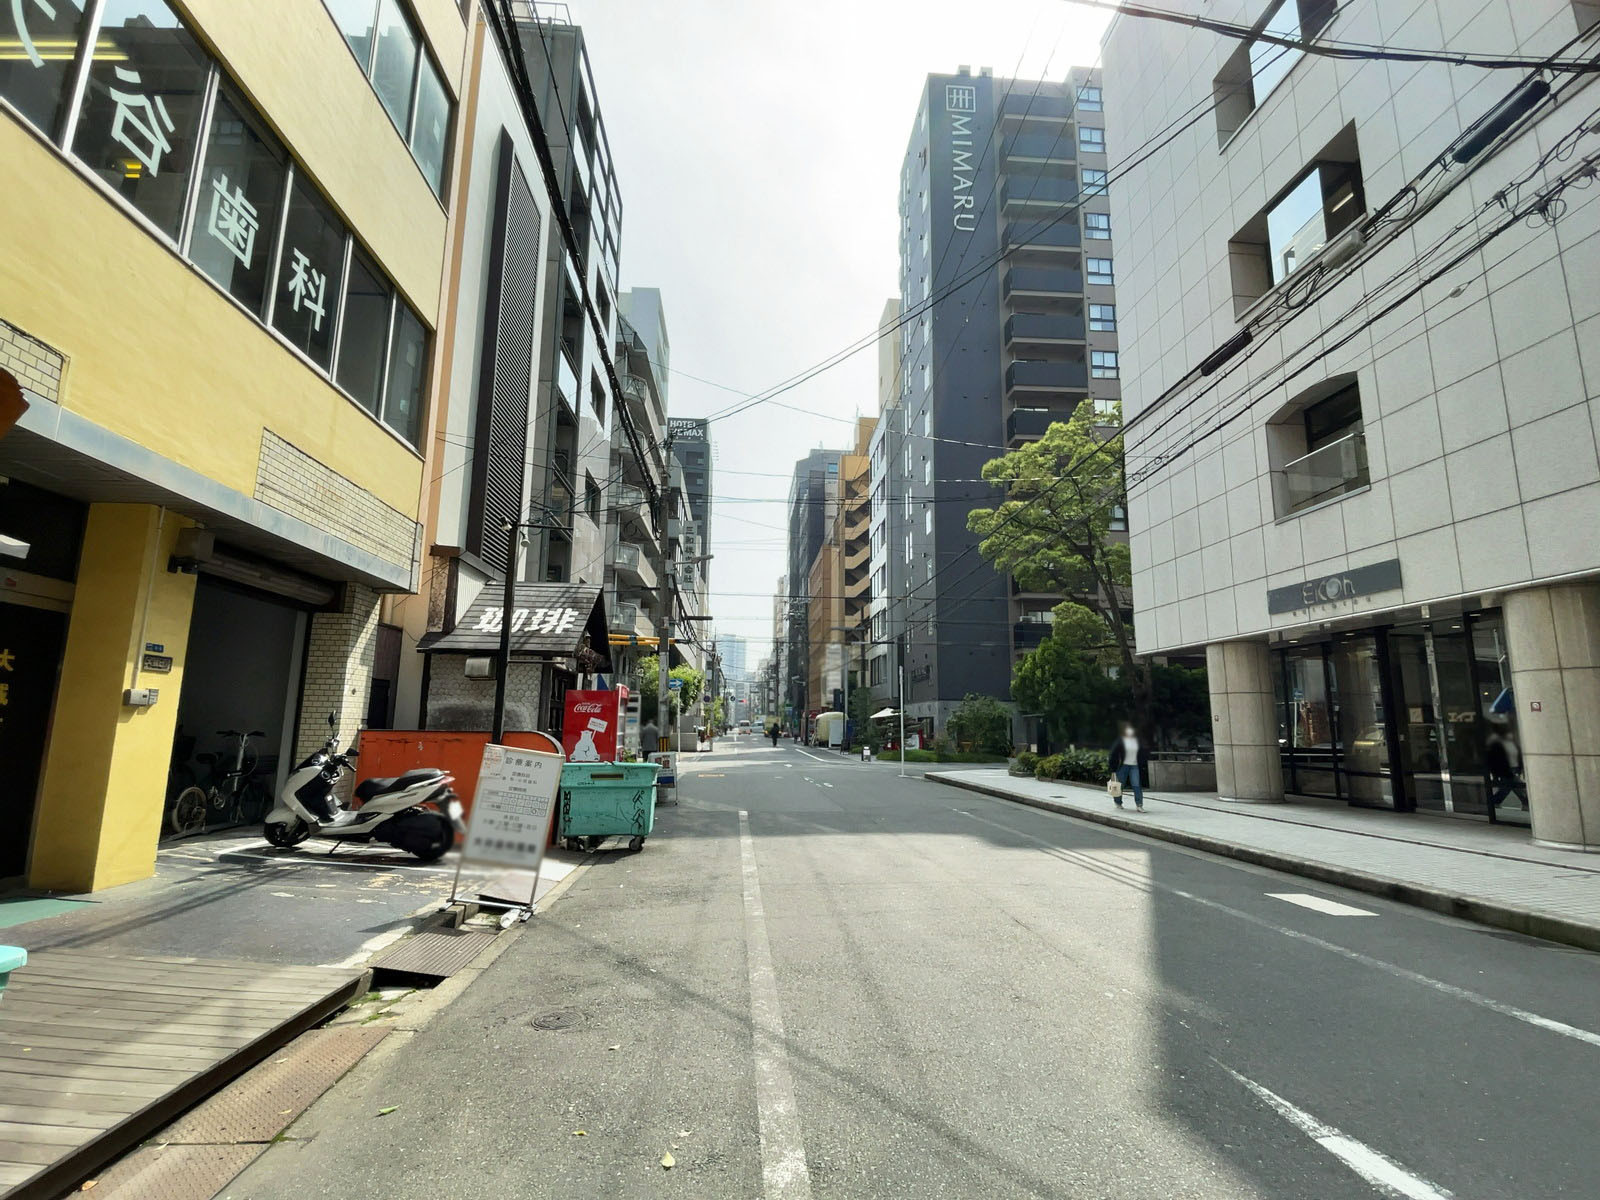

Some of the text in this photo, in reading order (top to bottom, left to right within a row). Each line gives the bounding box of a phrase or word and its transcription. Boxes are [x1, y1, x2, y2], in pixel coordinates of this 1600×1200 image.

[951, 114, 975, 232] MIMARU
[669, 420, 698, 429] HOTEL
[472, 607, 579, 634] 珈琲
